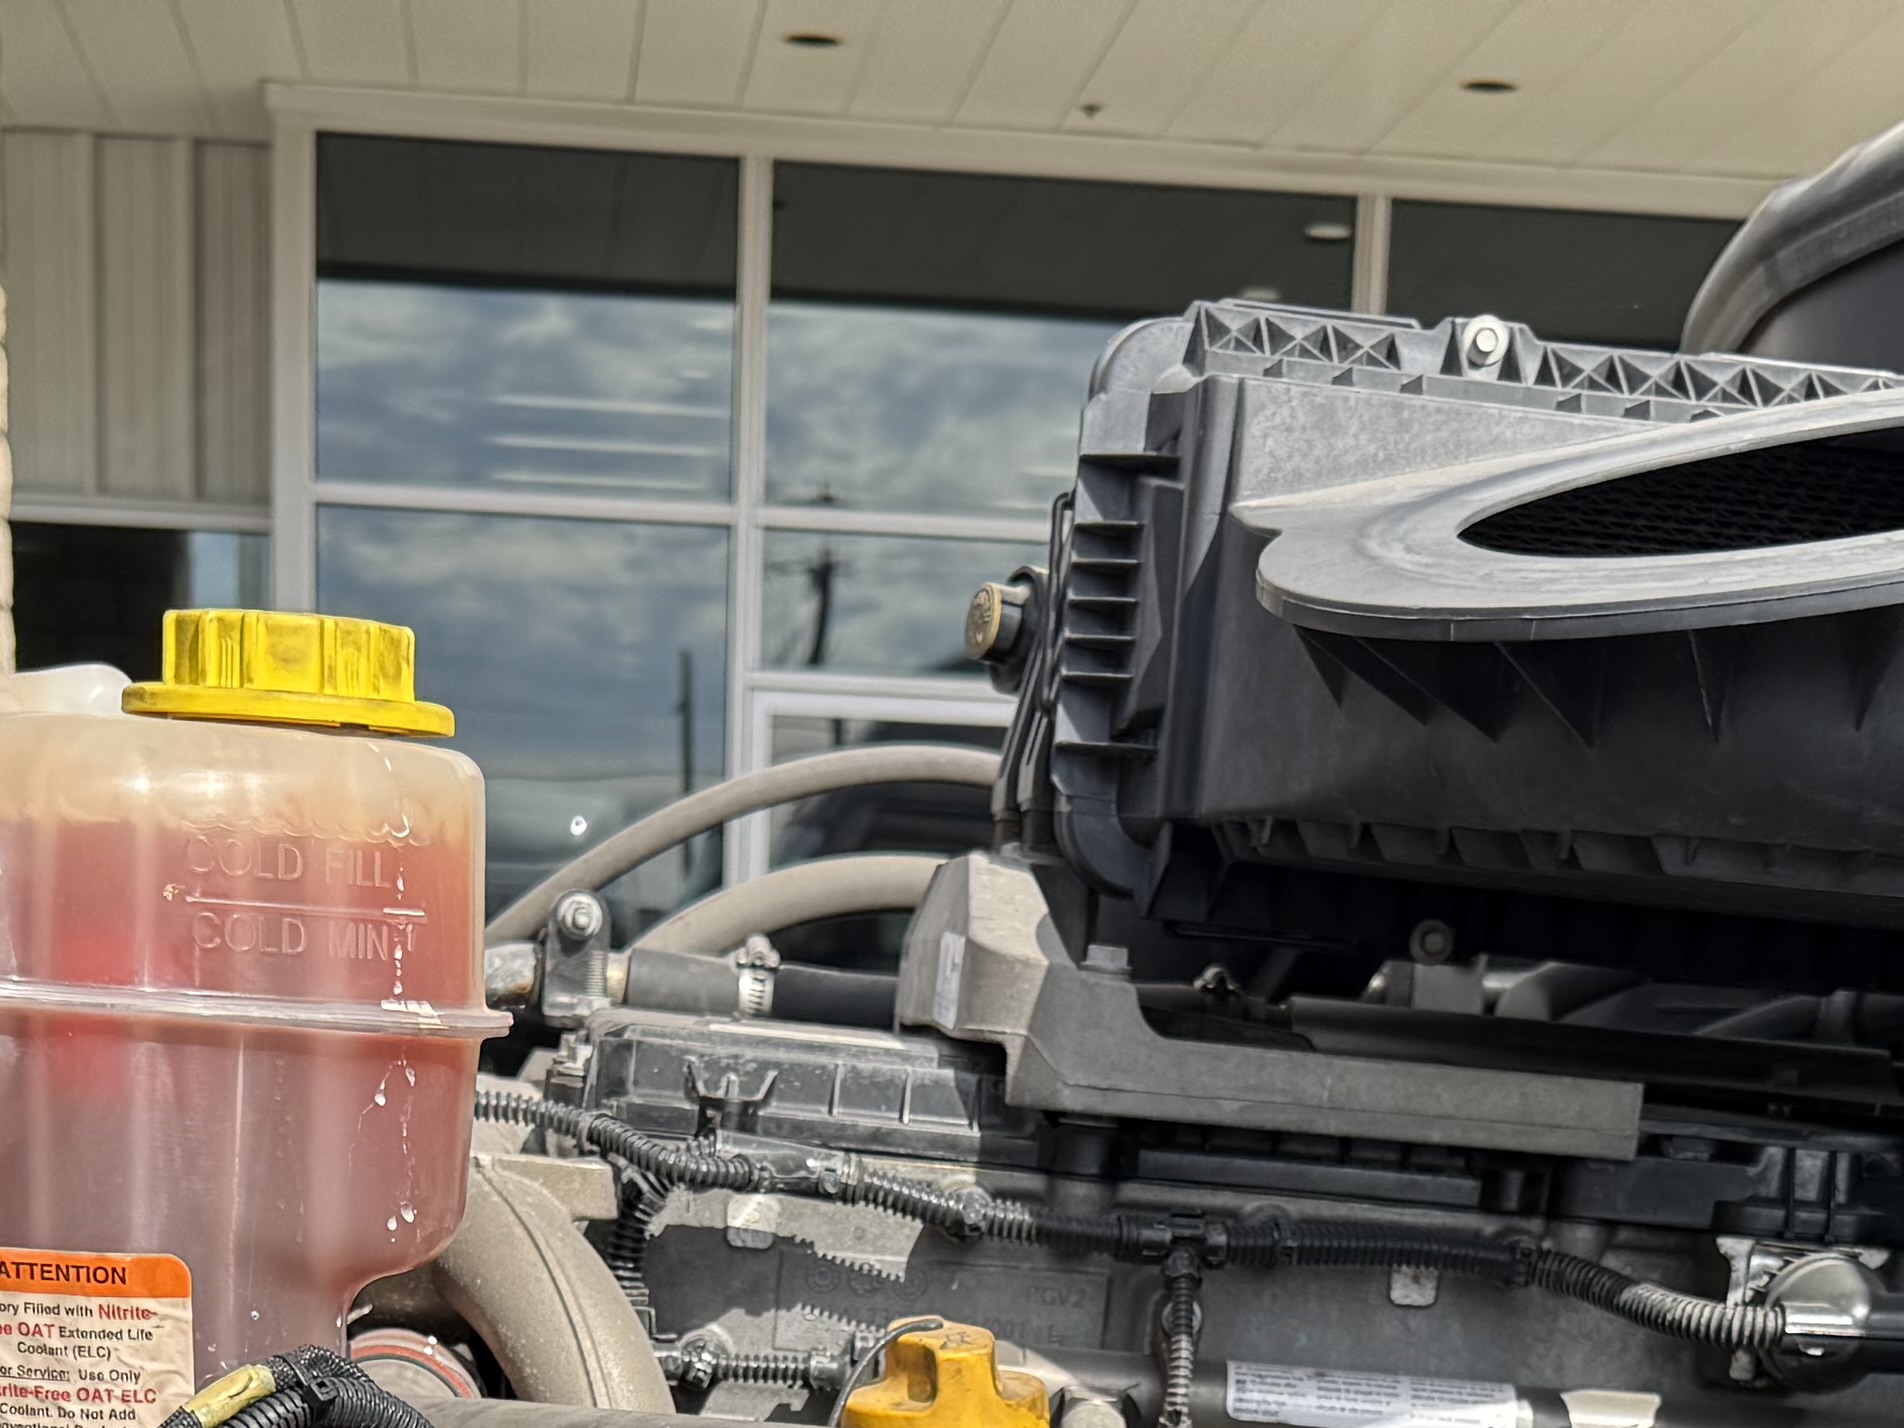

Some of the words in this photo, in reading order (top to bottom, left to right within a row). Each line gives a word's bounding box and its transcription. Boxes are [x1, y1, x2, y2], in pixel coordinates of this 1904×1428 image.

[185, 835, 304, 880] COLD
[326, 845, 391, 888] FILL
[193, 911, 306, 955] COLD
[24, 1302, 60, 1316] Filled
[64, 1304, 93, 1318] with
[18, 1321, 55, 1339] OAT
[59, 1326, 124, 1341] Extended
[127, 1327, 153, 1341] Life
[17, 1341, 69, 1358] Coolant
[72, 1345, 112, 1361] (ELC)
[17, 1364, 70, 1381] Service:
[78, 1369, 107, 1382] Use
[109, 1369, 141, 1384] Only
[76, 1387, 114, 1403] OAT
[121, 1388, 157, 1404] ELC
[0, 1402, 53, 1418] Coolant.
[58, 1406, 76, 1420] Do
[80, 1408, 104, 1421] Not
[108, 1408, 136, 1421] Add
